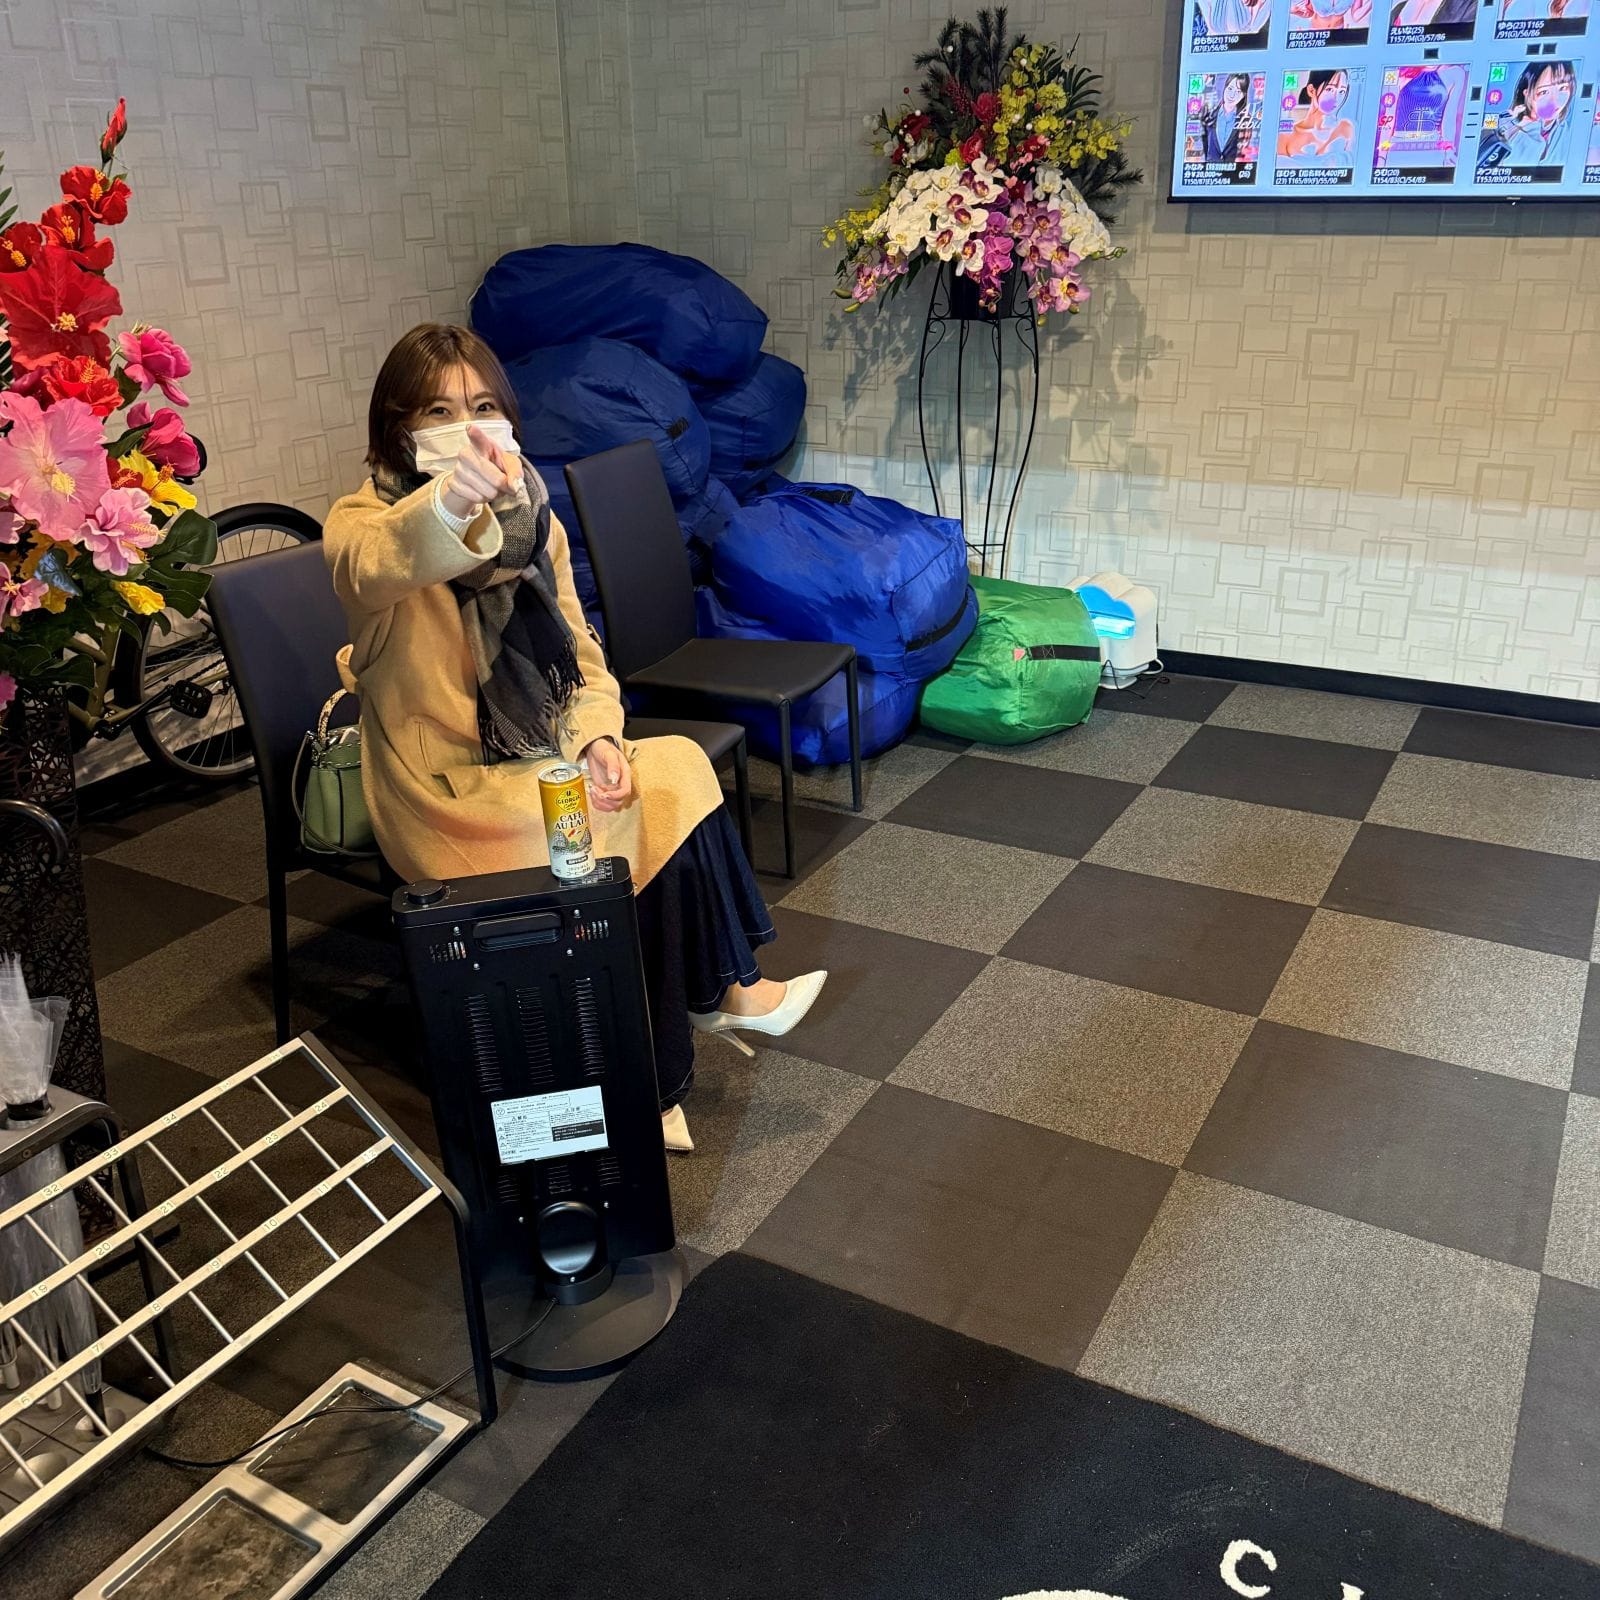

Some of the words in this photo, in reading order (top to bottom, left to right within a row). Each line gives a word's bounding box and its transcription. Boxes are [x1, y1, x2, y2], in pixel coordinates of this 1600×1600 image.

[555, 821, 568, 830] AU
[265, 1132, 279, 1144] 23
[104, 1147, 119, 1160] 33
[214, 1166, 229, 1179] 22
[44, 1183, 61, 1197] 32
[160, 1201, 175, 1214] 21
[263, 1217, 278, 1230] 10
[96, 1242, 112, 1256] 20
[31, 1284, 48, 1297] 19
[152, 1302, 161, 1312] 8
[92, 1343, 101, 1354] 7
